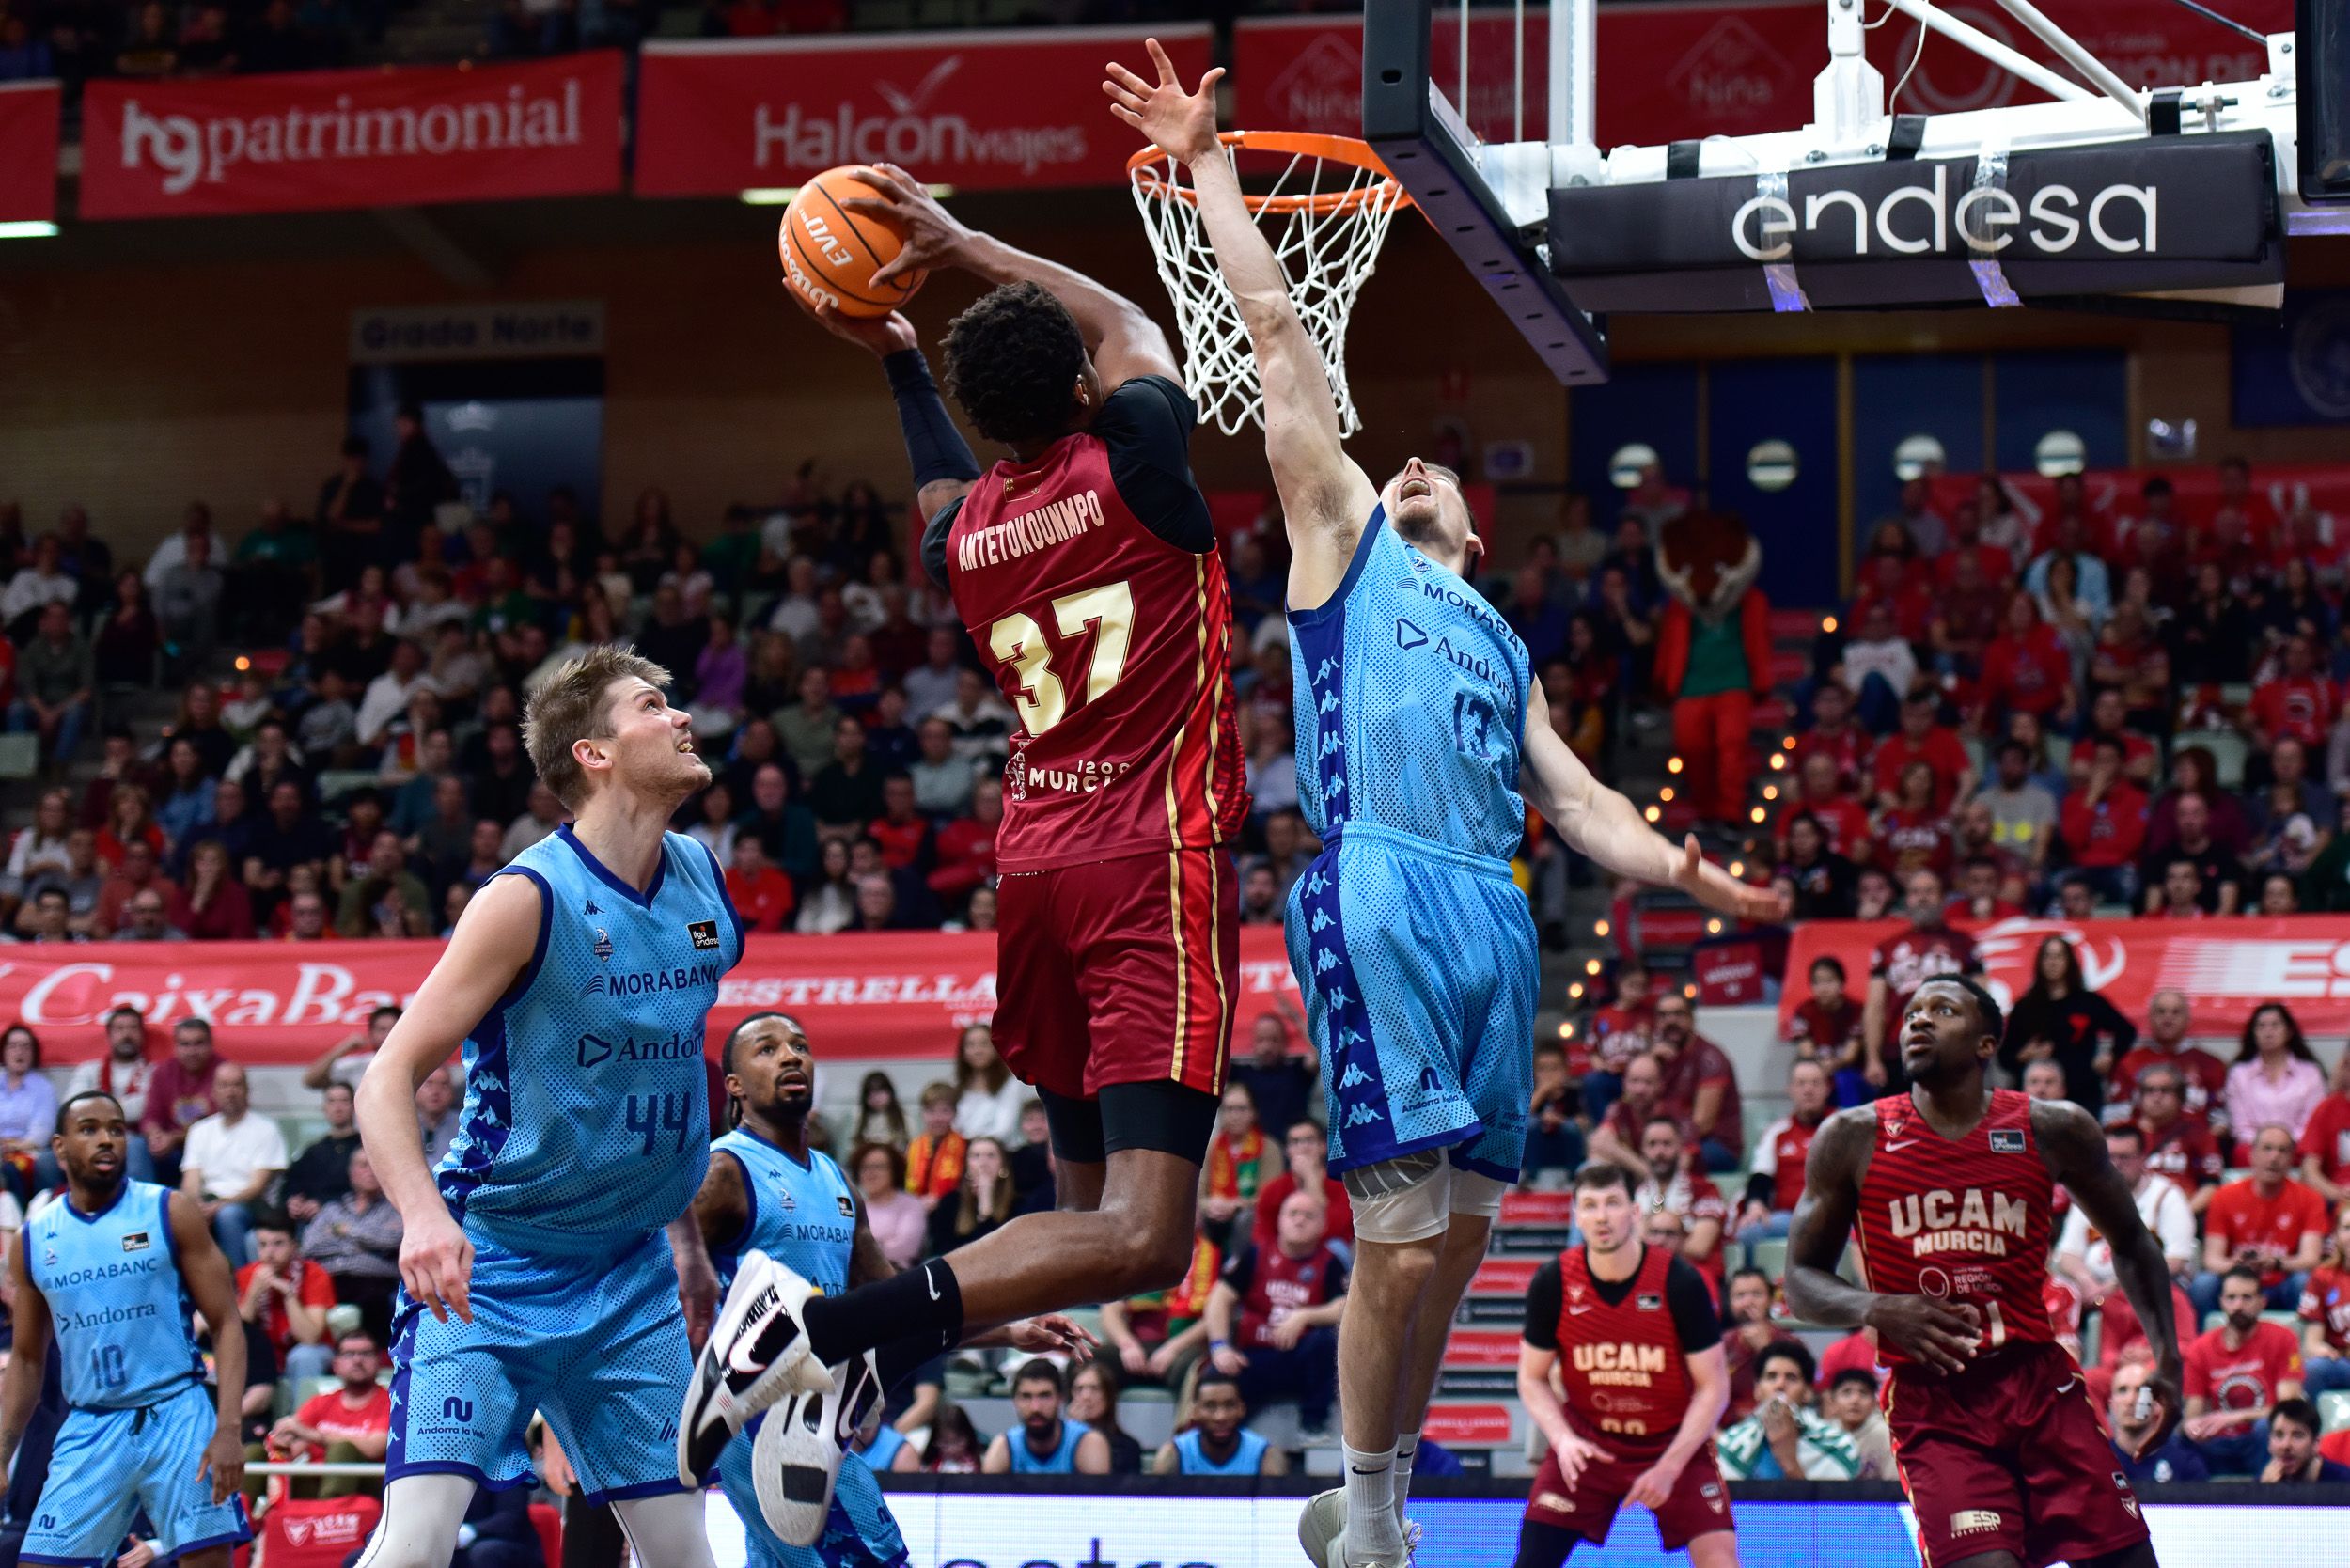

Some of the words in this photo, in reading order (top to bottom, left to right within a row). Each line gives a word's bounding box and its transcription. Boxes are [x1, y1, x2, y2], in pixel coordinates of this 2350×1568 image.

[208, 79, 582, 183] patrimonial
[1731, 165, 2157, 261] endesa
[780, 223, 839, 308] Wilson
[805, 216, 853, 267] EVO
[958, 489, 1104, 572] ANTETOKOUNMPO
[1424, 582, 1523, 656] MORABA
[989, 580, 1136, 737] 37
[1454, 692, 1494, 759] 13
[1029, 767, 1116, 793] MURCI
[21, 962, 416, 1026] CaixaBa
[626, 1091, 691, 1156] 44
[796, 1224, 851, 1244] MORABA
[1888, 1188, 2028, 1240] UCAM
[1913, 1230, 2008, 1259] MURCIA
[54, 1258, 157, 1289] MORABANC
[73, 1303, 157, 1330] Andorra
[91, 1344, 127, 1389] 10
[1573, 1341, 1666, 1373] UCAM
[417, 1426, 460, 1435] Andorra
[462, 1426, 471, 1435] la
